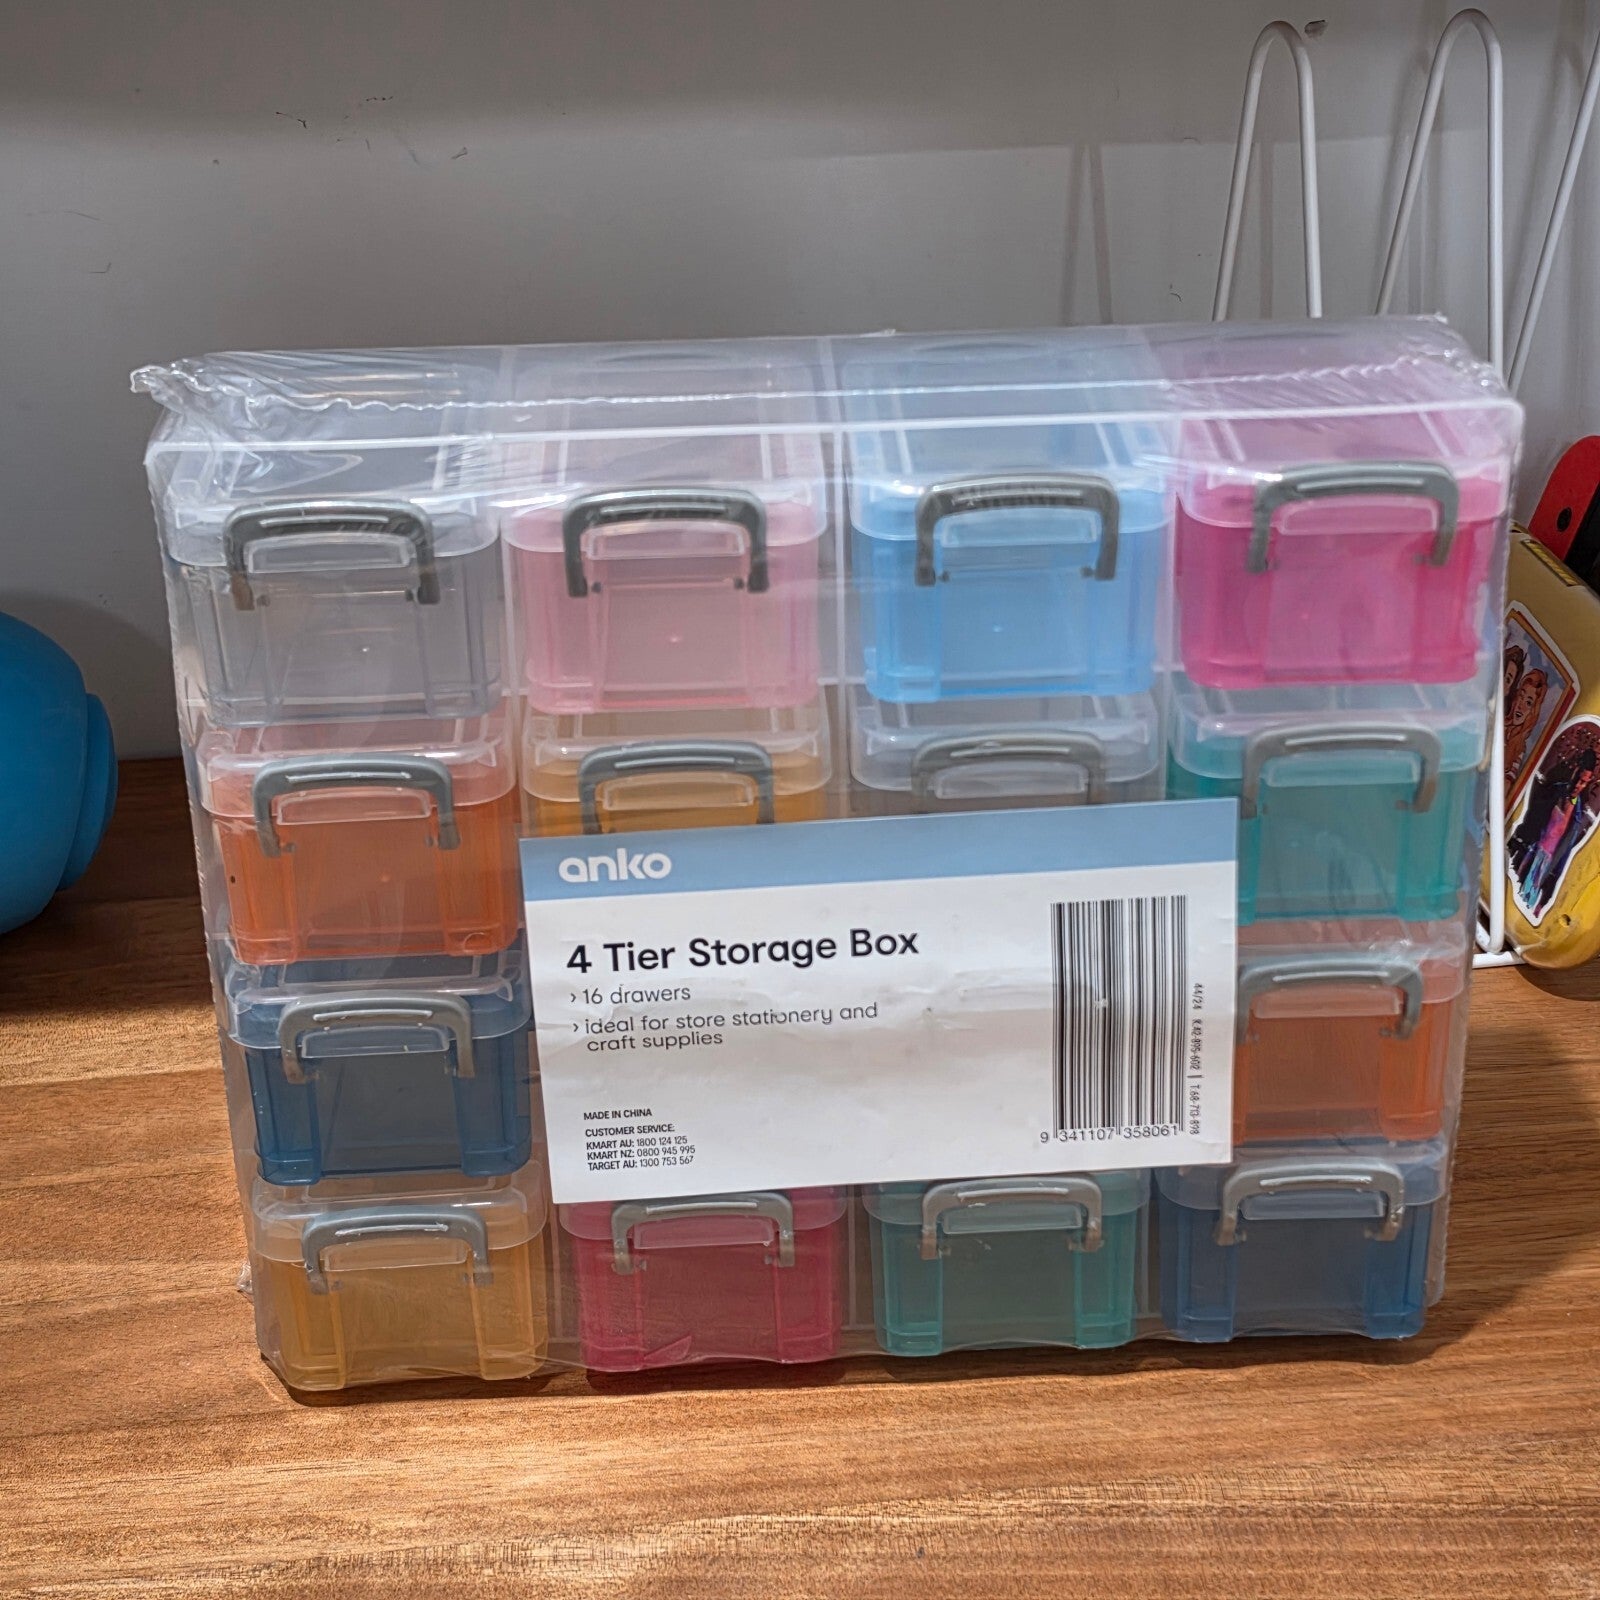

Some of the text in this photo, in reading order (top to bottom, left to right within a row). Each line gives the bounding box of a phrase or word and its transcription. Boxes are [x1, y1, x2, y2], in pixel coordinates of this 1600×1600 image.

[559, 847, 672, 883] anko
[567, 928, 919, 974] 4 Tier Storage Box
[582, 984, 691, 1005] 16 drawers
[585, 1002, 878, 1034] ideal for store stationery and
[587, 1030, 723, 1052] craft supplies
[584, 1109, 652, 1120] MADE IN CHINA
[585, 1124, 675, 1137] CUSTOMER SERVICE:
[1040, 1126, 1178, 1143] 9 341107 358061
[586, 1136, 687, 1150] KMART AU: 1800 124 125
[587, 1145, 695, 1160] KMART NZ: 0800 945 995
[588, 1155, 693, 1171] TARGET AU: 1300 753 567
